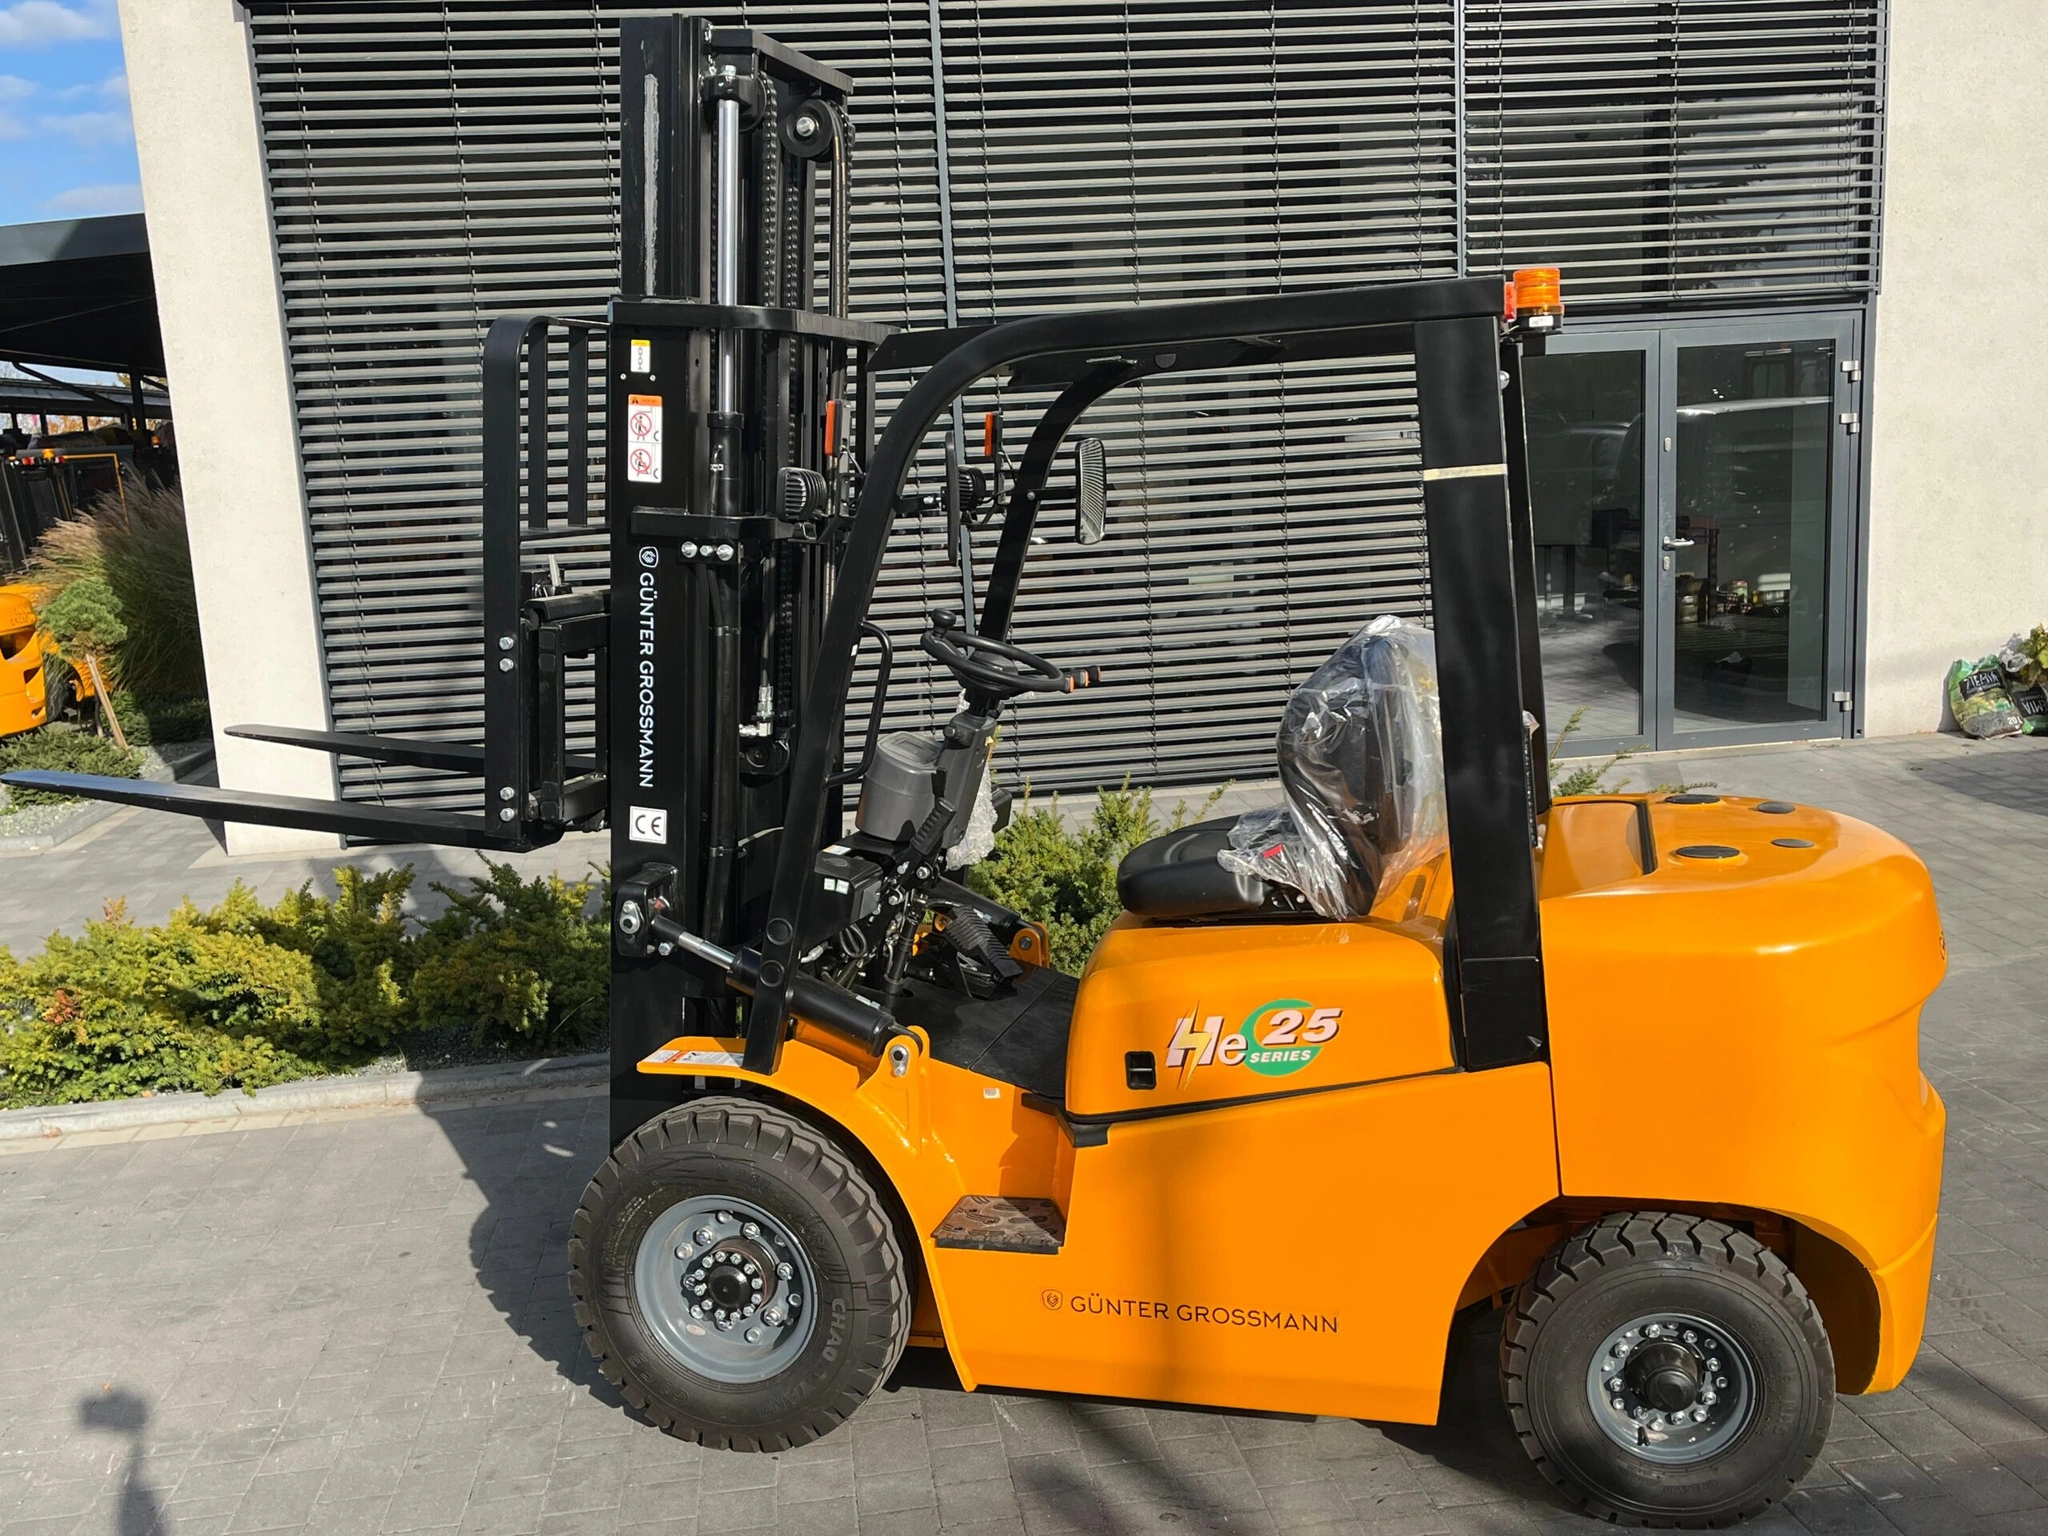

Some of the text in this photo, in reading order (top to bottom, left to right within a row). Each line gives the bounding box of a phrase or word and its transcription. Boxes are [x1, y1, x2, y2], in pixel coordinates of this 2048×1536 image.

[639, 572, 658, 788] GÜNTER GROSSMANN
[635, 814, 662, 837] CE
[1261, 1007, 1344, 1047] 25
[1249, 1049, 1312, 1064] SERIES
[822, 1297, 847, 1363] CHAO
[1070, 1292, 1338, 1334] GÜNTER GROSSMANN
